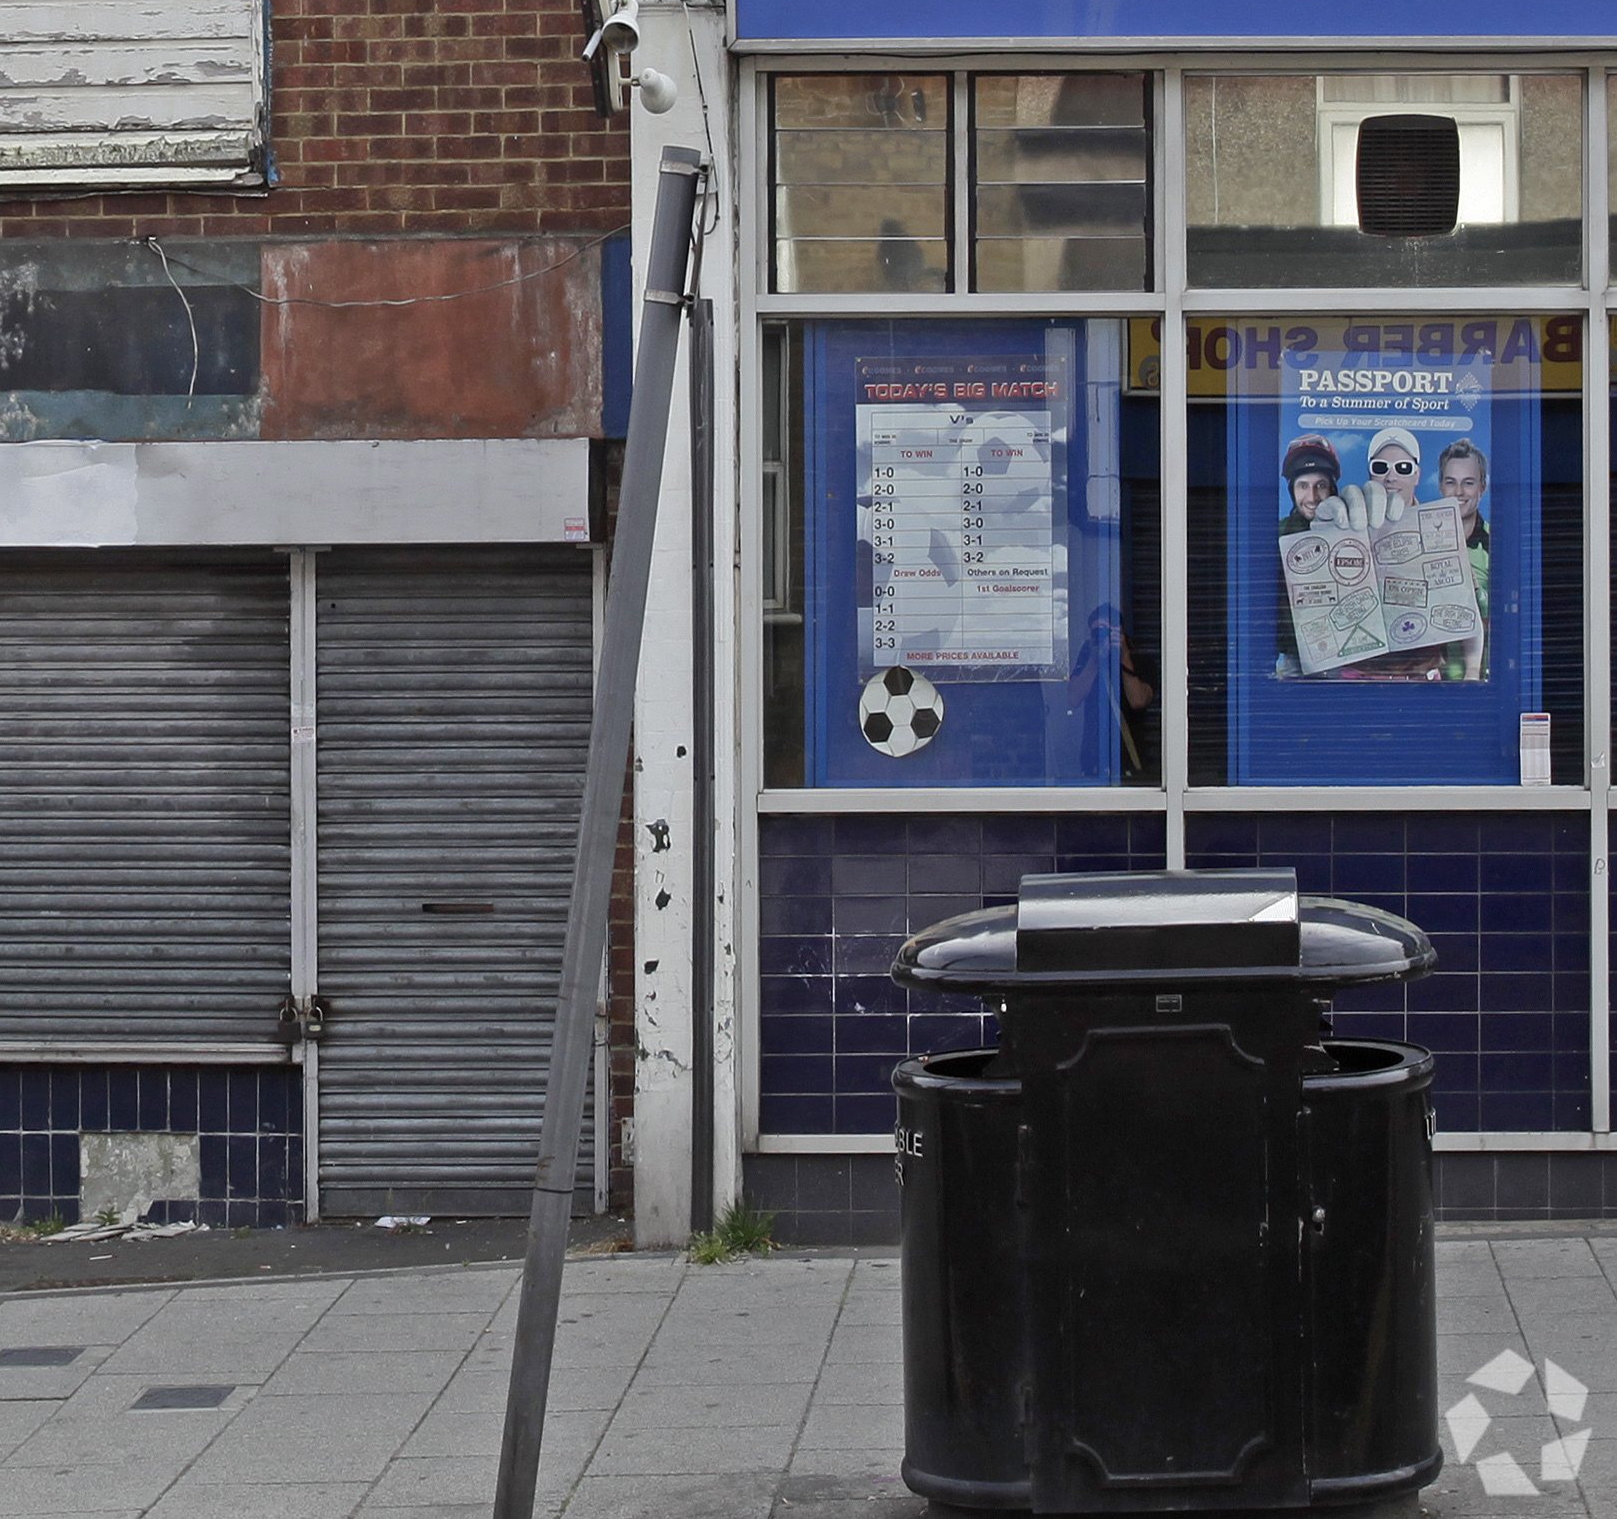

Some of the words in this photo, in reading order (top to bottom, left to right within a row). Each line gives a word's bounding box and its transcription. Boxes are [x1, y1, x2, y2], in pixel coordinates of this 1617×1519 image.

[1299, 370, 1453, 393] PASSPORT
[864, 383, 948, 399] TODAY'S
[953, 383, 986, 398] BIG
[991, 382, 1059, 398] MATCH
[1300, 396, 1316, 408] To
[1320, 399, 1328, 408] a
[1332, 396, 1391, 409] Summer
[1395, 397, 1409, 409] of
[1412, 397, 1450, 413] Sport
[1315, 417, 1333, 425] Pick
[1336, 418, 1348, 426] Up
[1351, 418, 1372, 426] Your
[1374, 417, 1428, 426] Scratchcard
[1430, 419, 1456, 428] Today
[901, 450, 913, 458] TO
[915, 450, 933, 458] WIN
[991, 449, 1003, 457] TO
[1006, 449, 1024, 457] WIN
[874, 467, 894, 478] 1-0
[963, 466, 983, 477] 1-0
[874, 484, 894, 495] 2-0
[963, 483, 983, 494] 2-0
[874, 501, 893, 513] 2-1
[963, 500, 982, 512] 2-1
[874, 518, 894, 530] 3-0
[963, 517, 983, 529] 3-0
[874, 535, 893, 547] 3-1
[963, 534, 982, 546] 3-1
[874, 553, 894, 564] 3-2
[963, 552, 983, 563] 3-2
[894, 569, 917, 577] Draw
[919, 569, 941, 577] Odds
[967, 568, 996, 576] Others
[1012, 568, 1048, 577] Request
[875, 586, 895, 597] 0-0
[976, 585, 990, 593] 1st
[993, 584, 1040, 592] Goalscorer
[875, 603, 894, 614] 1-1
[875, 621, 895, 631] 2-2
[875, 637, 895, 648] 3-3
[936, 652, 969, 660] PRICES
